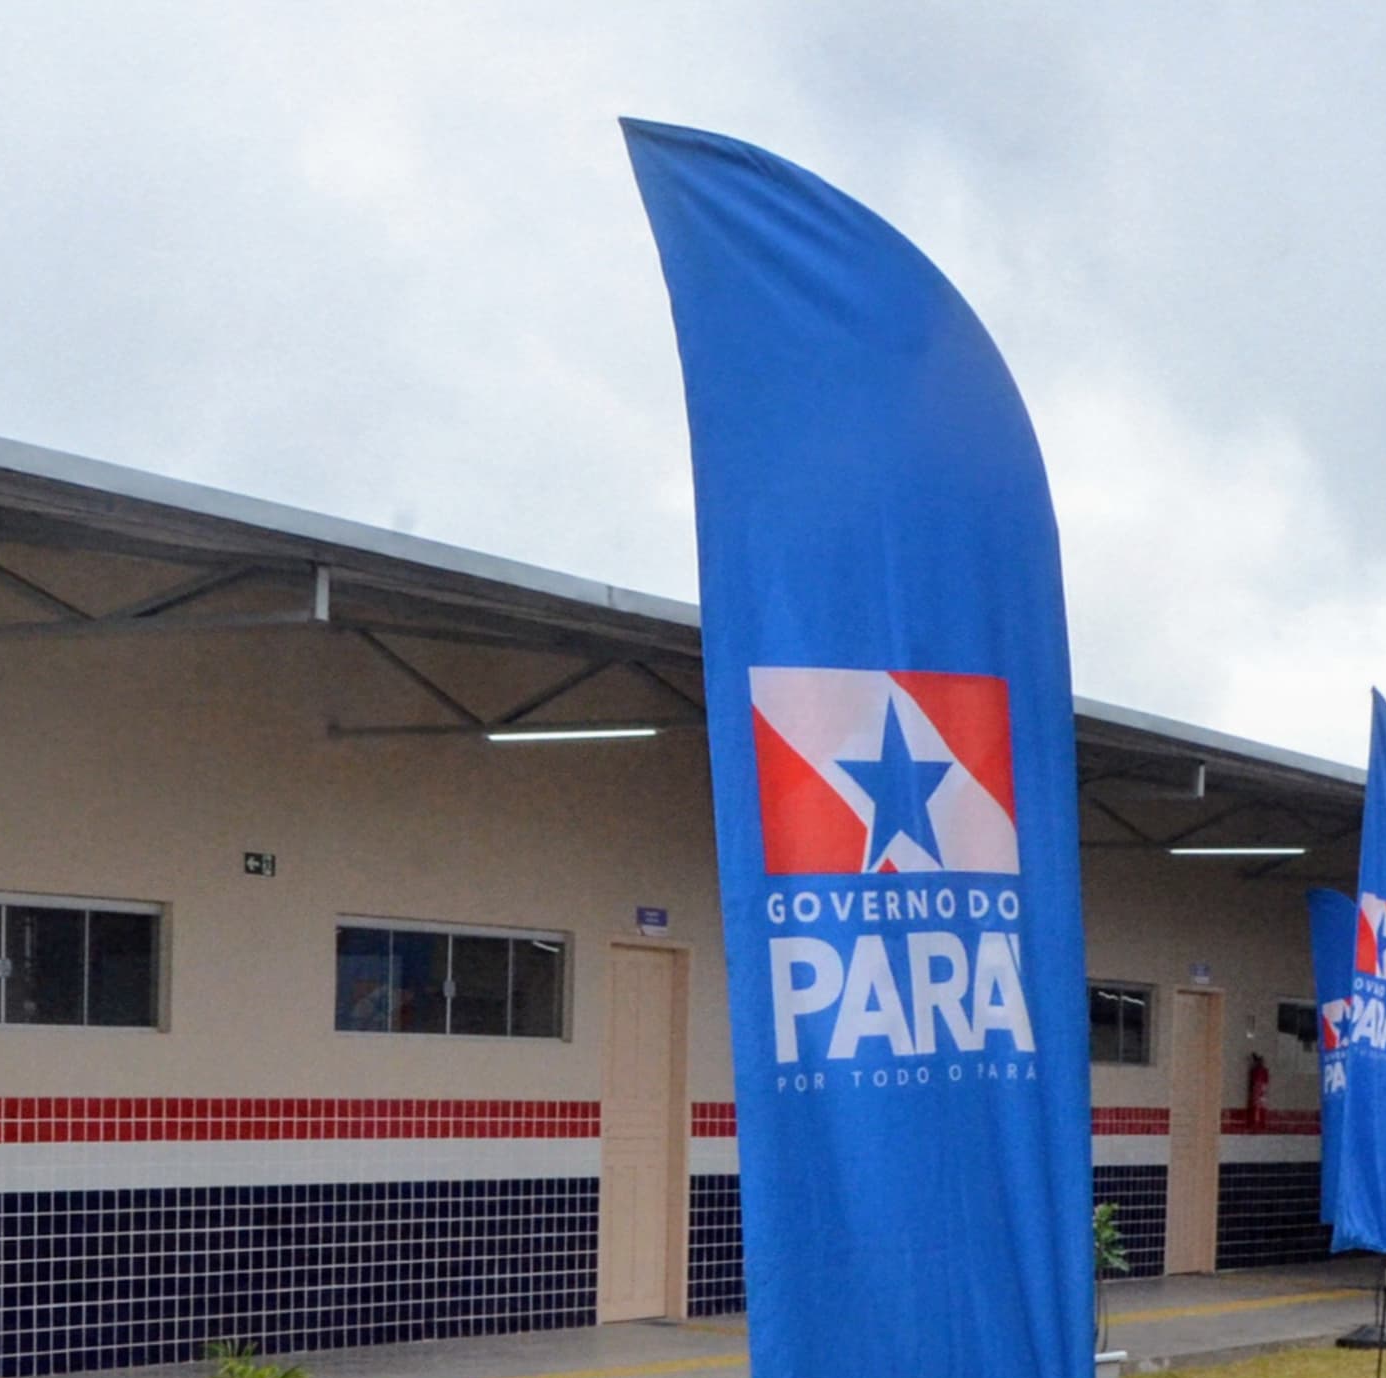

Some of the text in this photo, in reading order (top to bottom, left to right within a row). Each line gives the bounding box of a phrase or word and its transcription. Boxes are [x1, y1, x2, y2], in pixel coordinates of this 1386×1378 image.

[766, 888, 1019, 924] GOVERNO DO
[768, 930, 1037, 1065] PARÁ
[777, 1072, 826, 1093] POR
[851, 1067, 930, 1088] TODO
[948, 1064, 963, 1081] O
